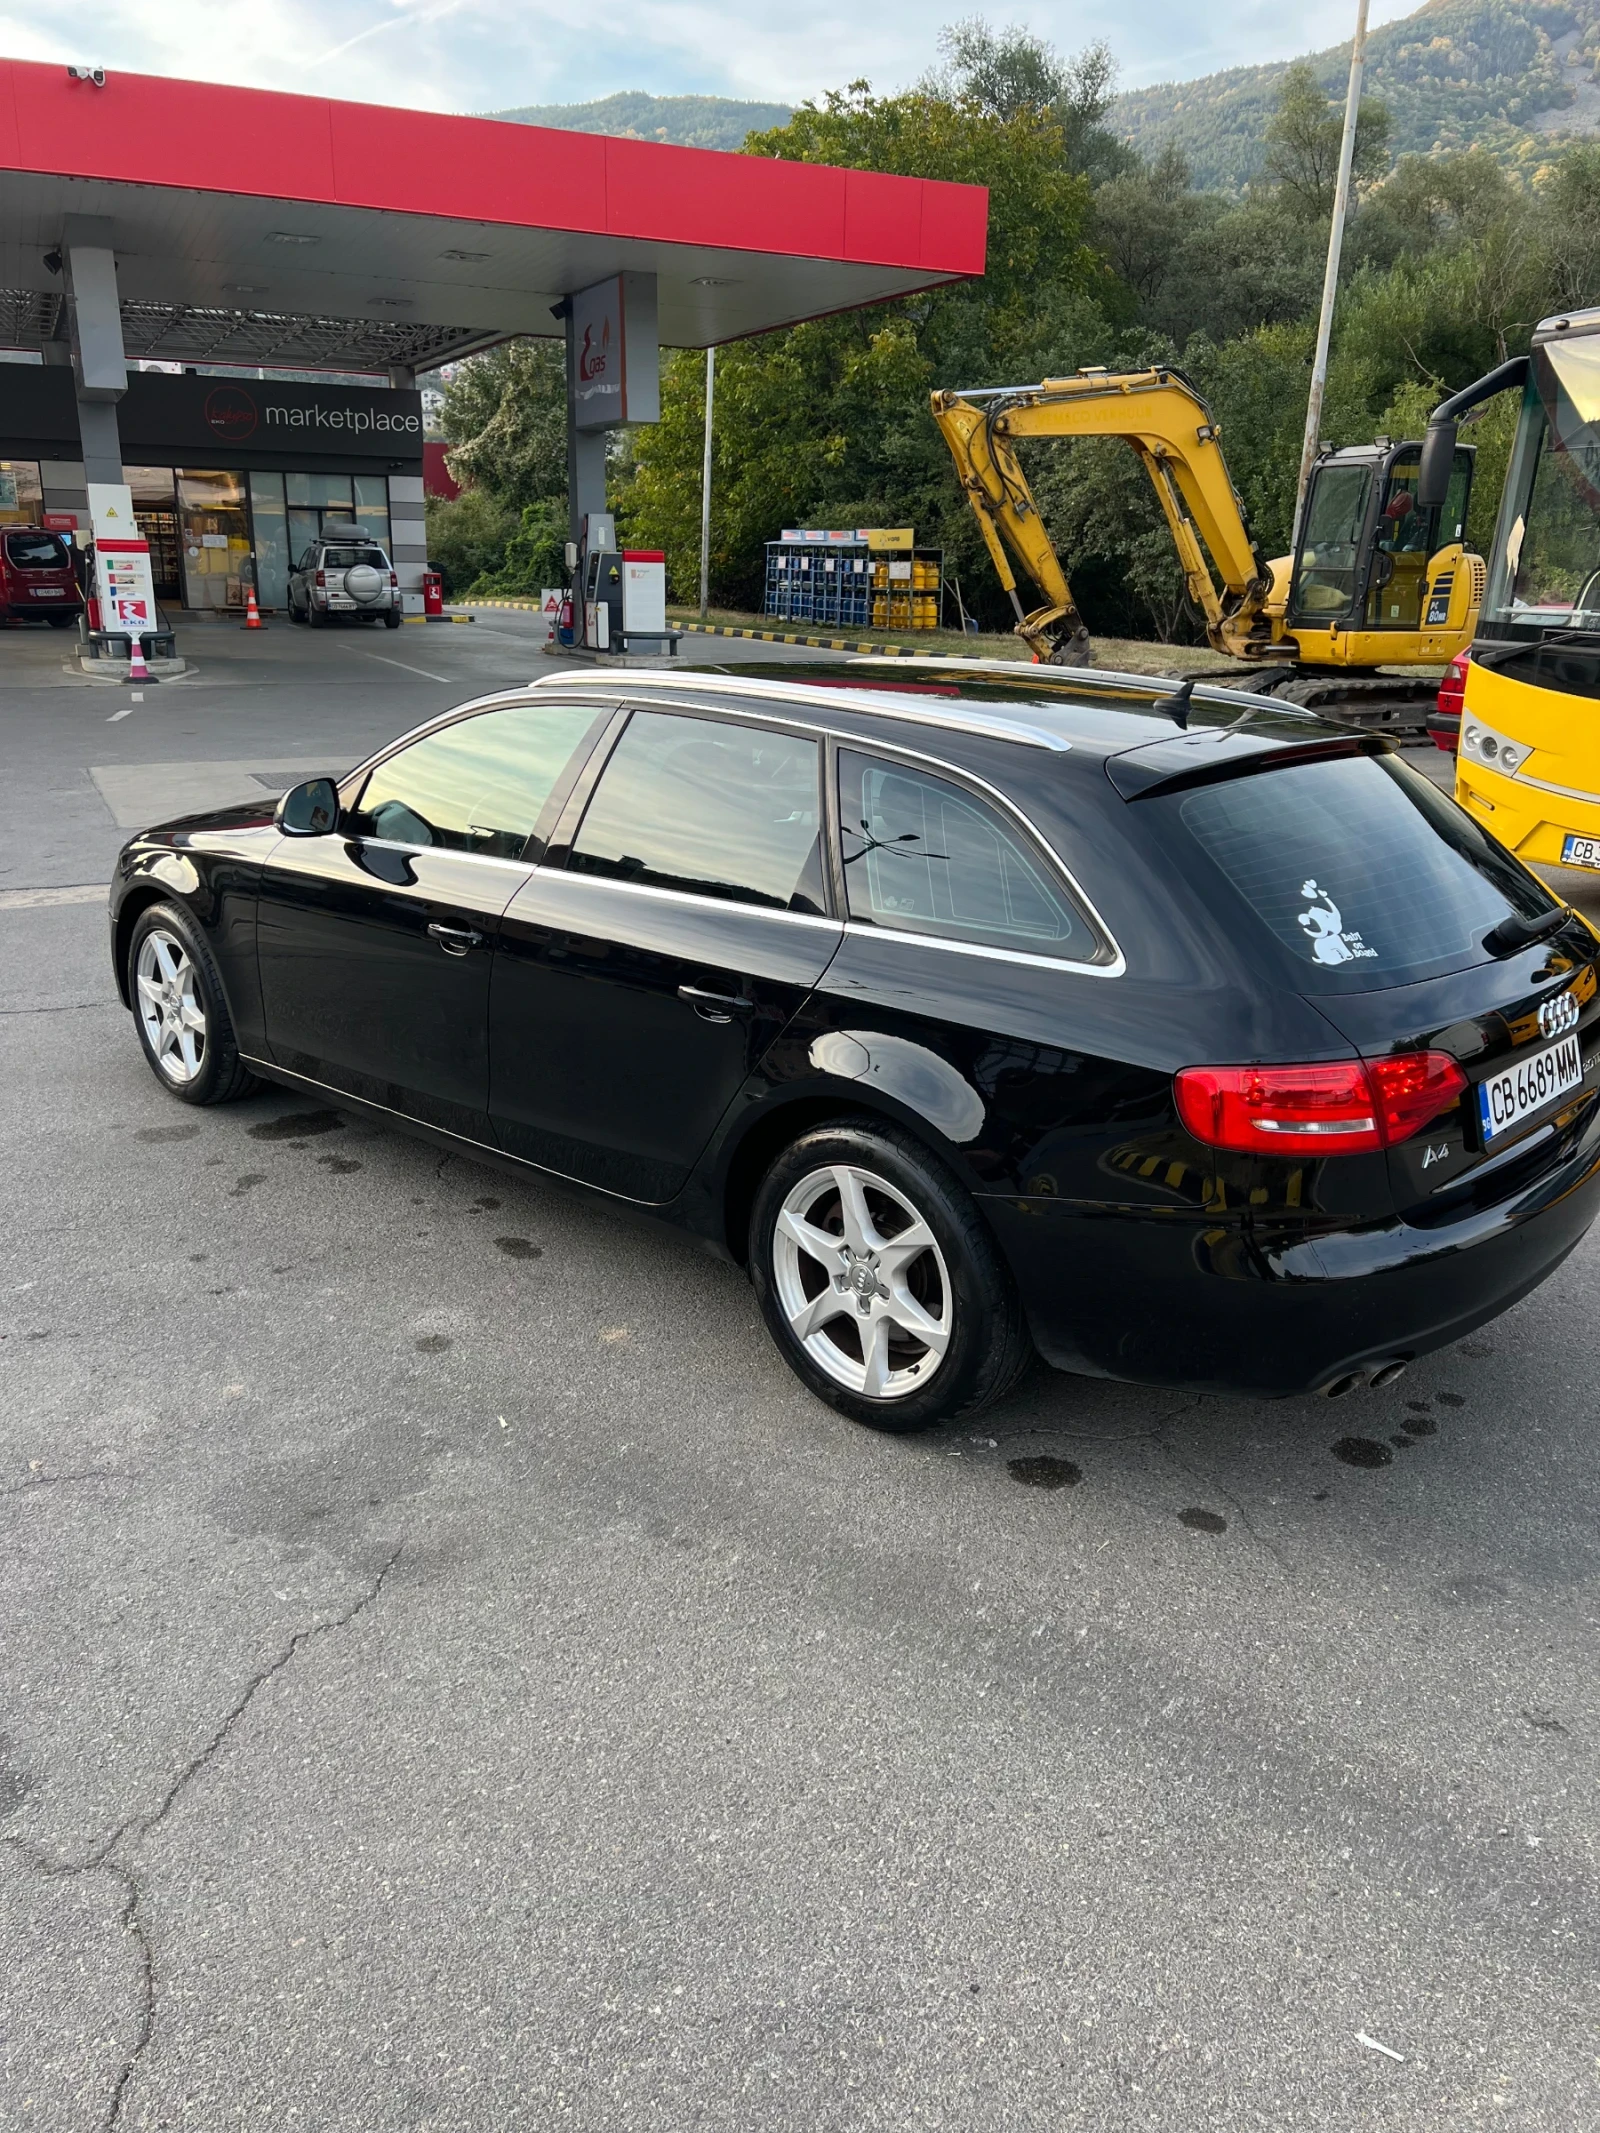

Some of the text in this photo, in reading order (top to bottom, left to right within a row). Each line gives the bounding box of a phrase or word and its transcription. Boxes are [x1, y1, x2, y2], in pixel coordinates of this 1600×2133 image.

[266, 404, 419, 434] marketplace
[1430, 601, 1439, 610] PC
[1574, 841, 1594, 859] CB
[1341, 932, 1363, 941] Baby
[1352, 948, 1379, 957] Board
[1491, 1039, 1579, 1125] CB 6689 MM
[1421, 1142, 1449, 1169] A4
